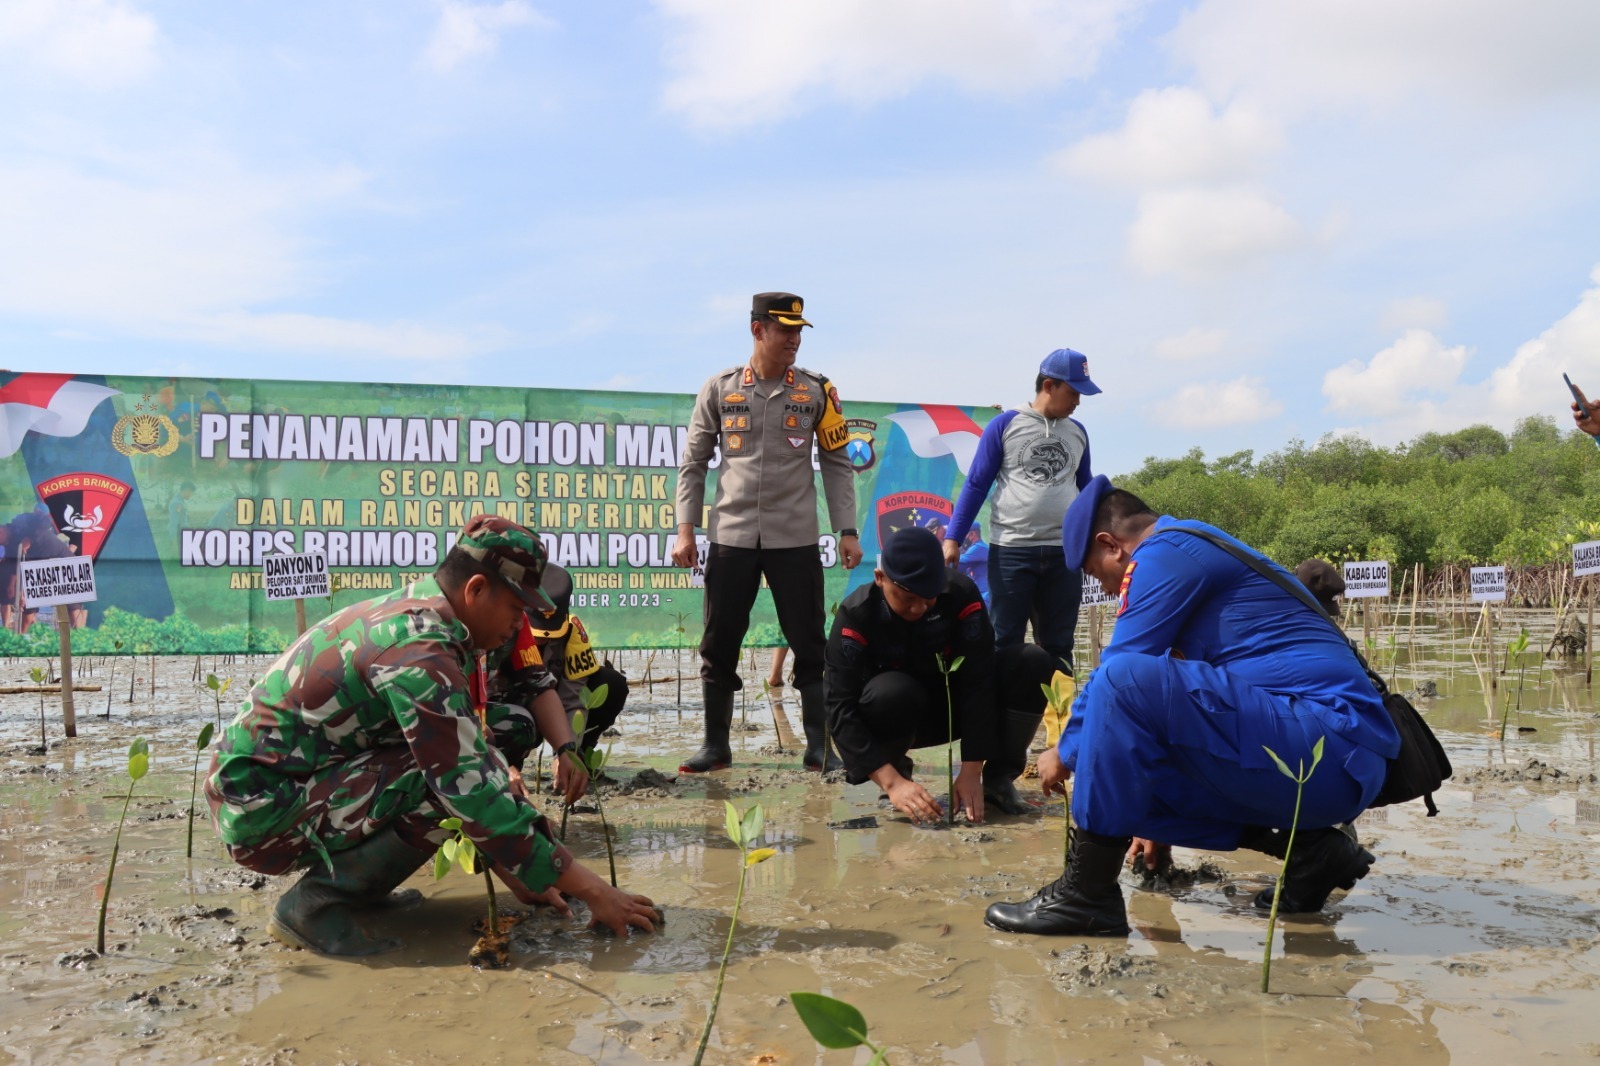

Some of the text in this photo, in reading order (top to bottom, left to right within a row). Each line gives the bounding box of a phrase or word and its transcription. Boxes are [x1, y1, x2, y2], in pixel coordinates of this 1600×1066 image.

[721, 405, 750, 413] SATRIA
[784, 404, 815, 414] POLRI
[200, 413, 458, 462] PENANAMAN
[469, 419, 605, 466] POHON
[42, 477, 125, 495] KORPS BRIMOB
[380, 469, 668, 500] SECARA SERENTAK
[884, 495, 945, 509] KORPOLAIRUD
[237, 498, 344, 526] DALAM
[181, 530, 296, 568] KORPS
[304, 531, 438, 568] BRIMOB
[266, 555, 324, 576] DANYON D
[1574, 559, 1600, 570] PAMEKAS
[61, 564, 77, 583] POL
[78, 563, 92, 581] AIR
[267, 574, 327, 587] PELOPOR SAT BRIMOB
[574, 573, 623, 589] TINGGI
[629, 574, 645, 589] DI
[1345, 566, 1387, 580] KABAG LOG
[27, 582, 93, 599] POLRES PAMEKASAN
[268, 584, 328, 598] POLDA JATIM
[619, 594, 660, 606] 2023
